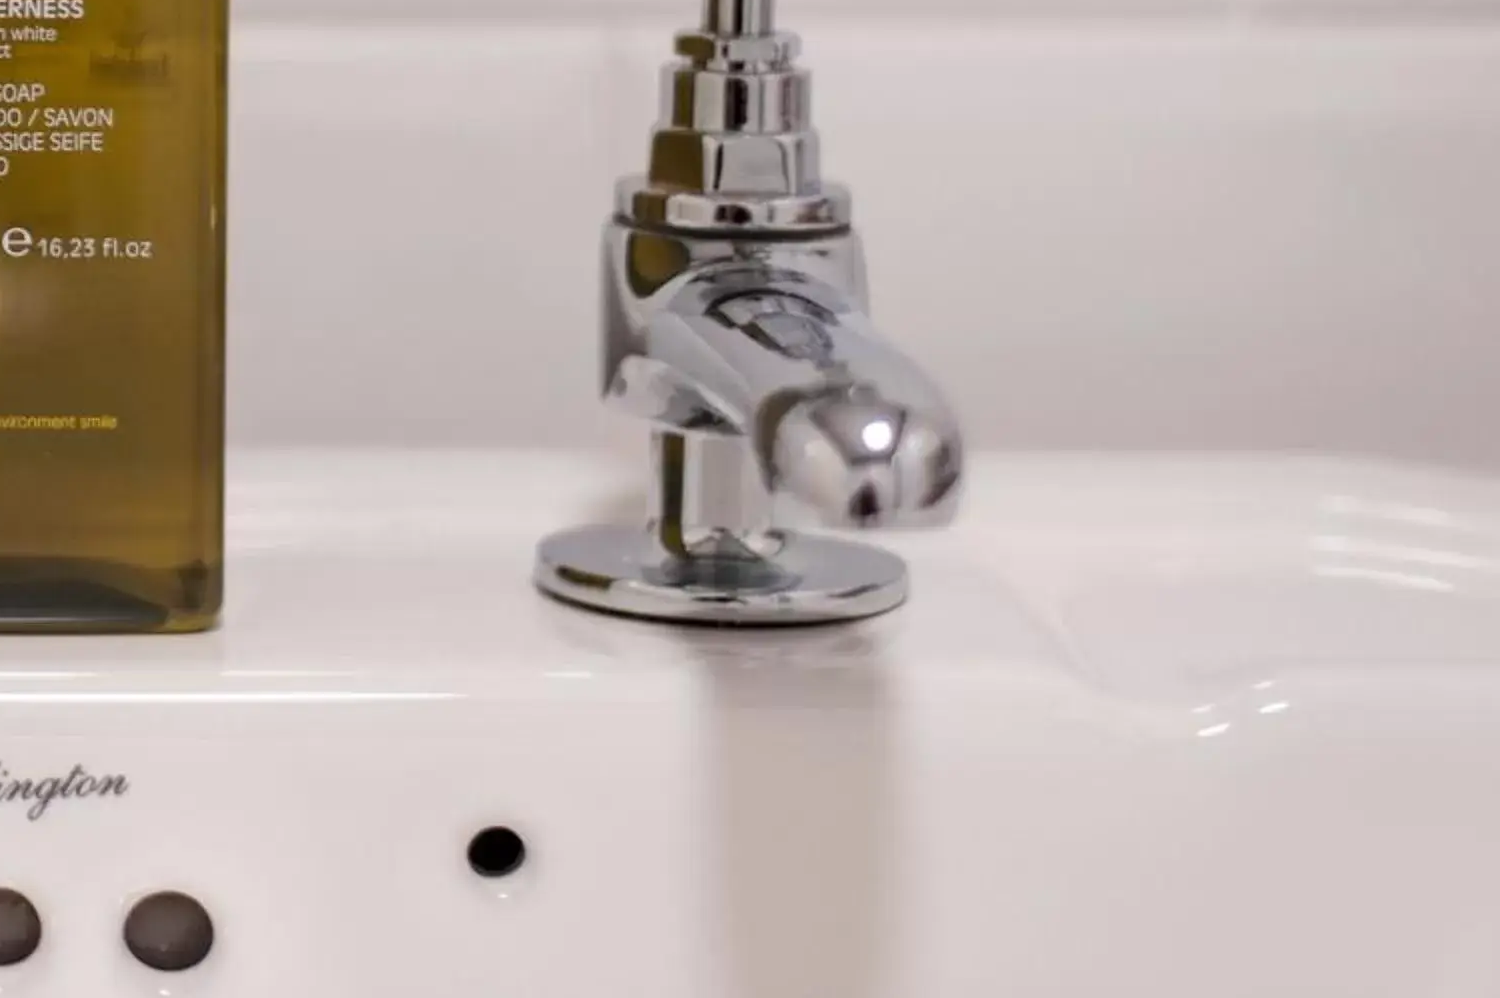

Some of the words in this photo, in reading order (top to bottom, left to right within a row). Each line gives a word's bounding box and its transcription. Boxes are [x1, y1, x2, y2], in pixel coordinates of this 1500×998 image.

[10, 26, 57, 41] white
[44, 108, 113, 127] SAVON
[49, 133, 104, 152] SEIFE
[103, 237, 153, 258] fl.oz
[80, 413, 117, 430] smile
